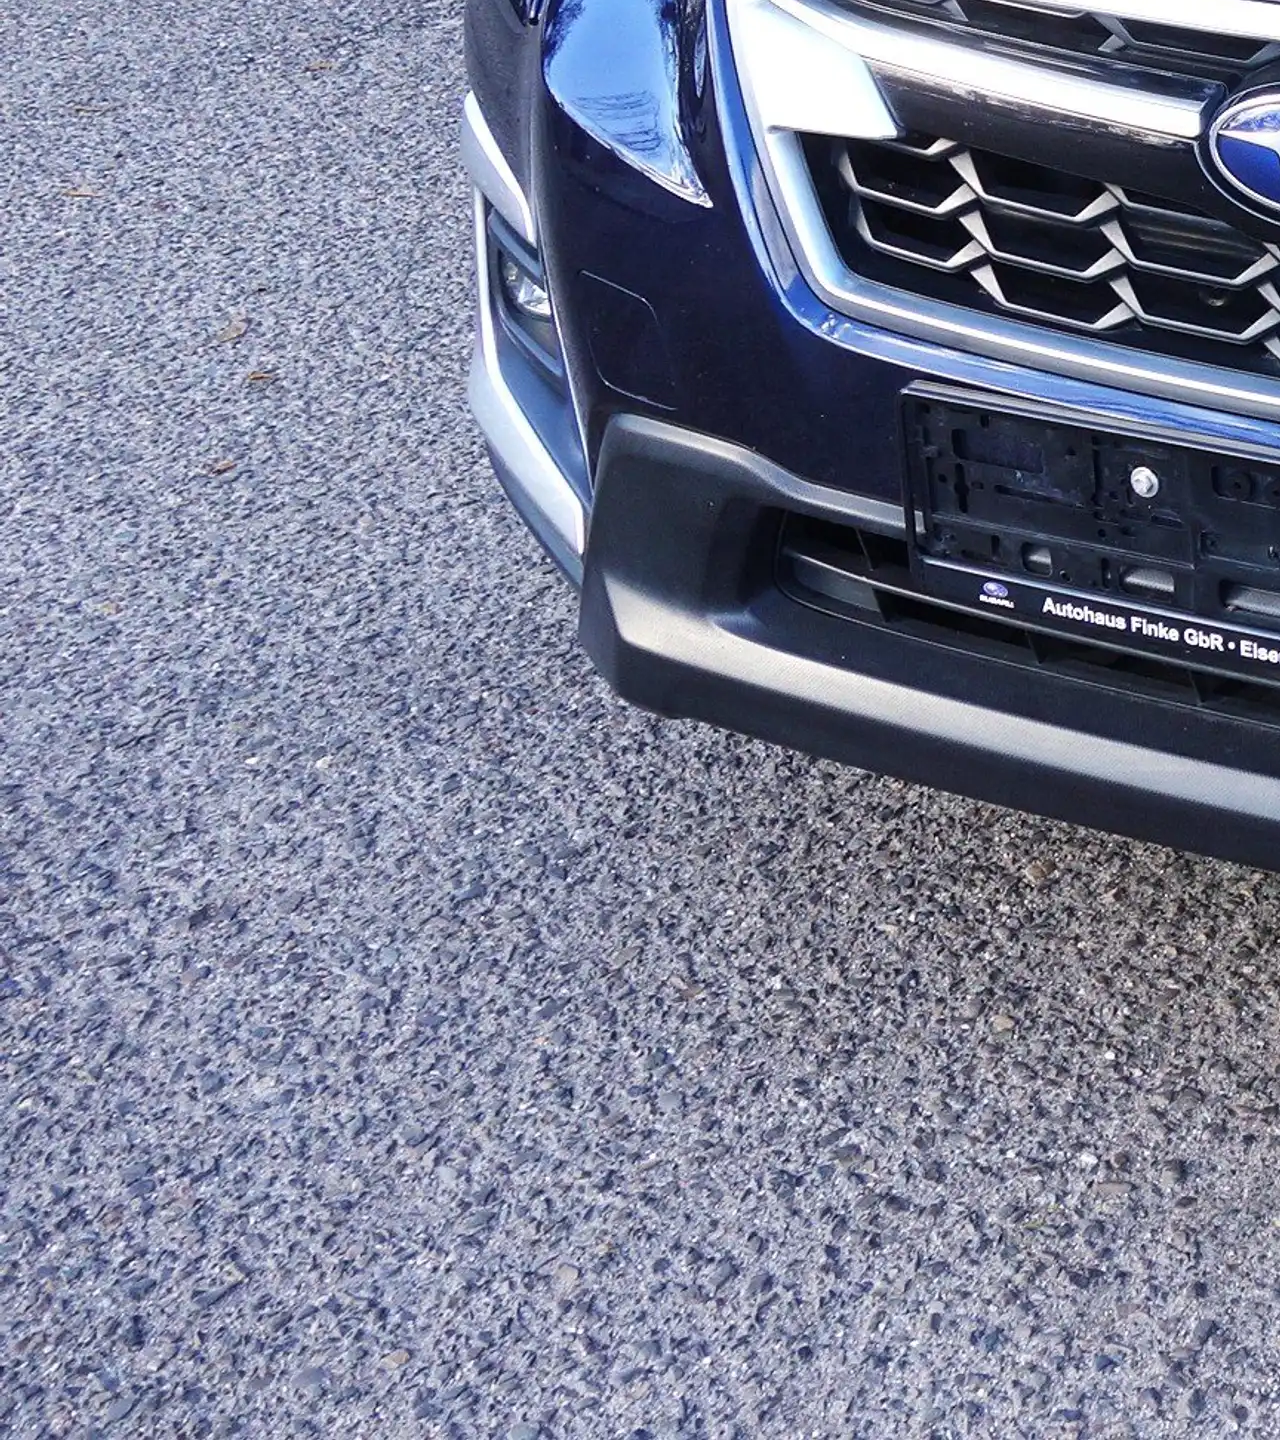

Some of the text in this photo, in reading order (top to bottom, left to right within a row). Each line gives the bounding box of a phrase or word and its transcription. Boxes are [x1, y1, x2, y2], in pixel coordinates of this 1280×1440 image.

[1041, 596, 1127, 631] Autohaus
[1130, 615, 1180, 642] Finke
[1183, 628, 1225, 652] GbR
